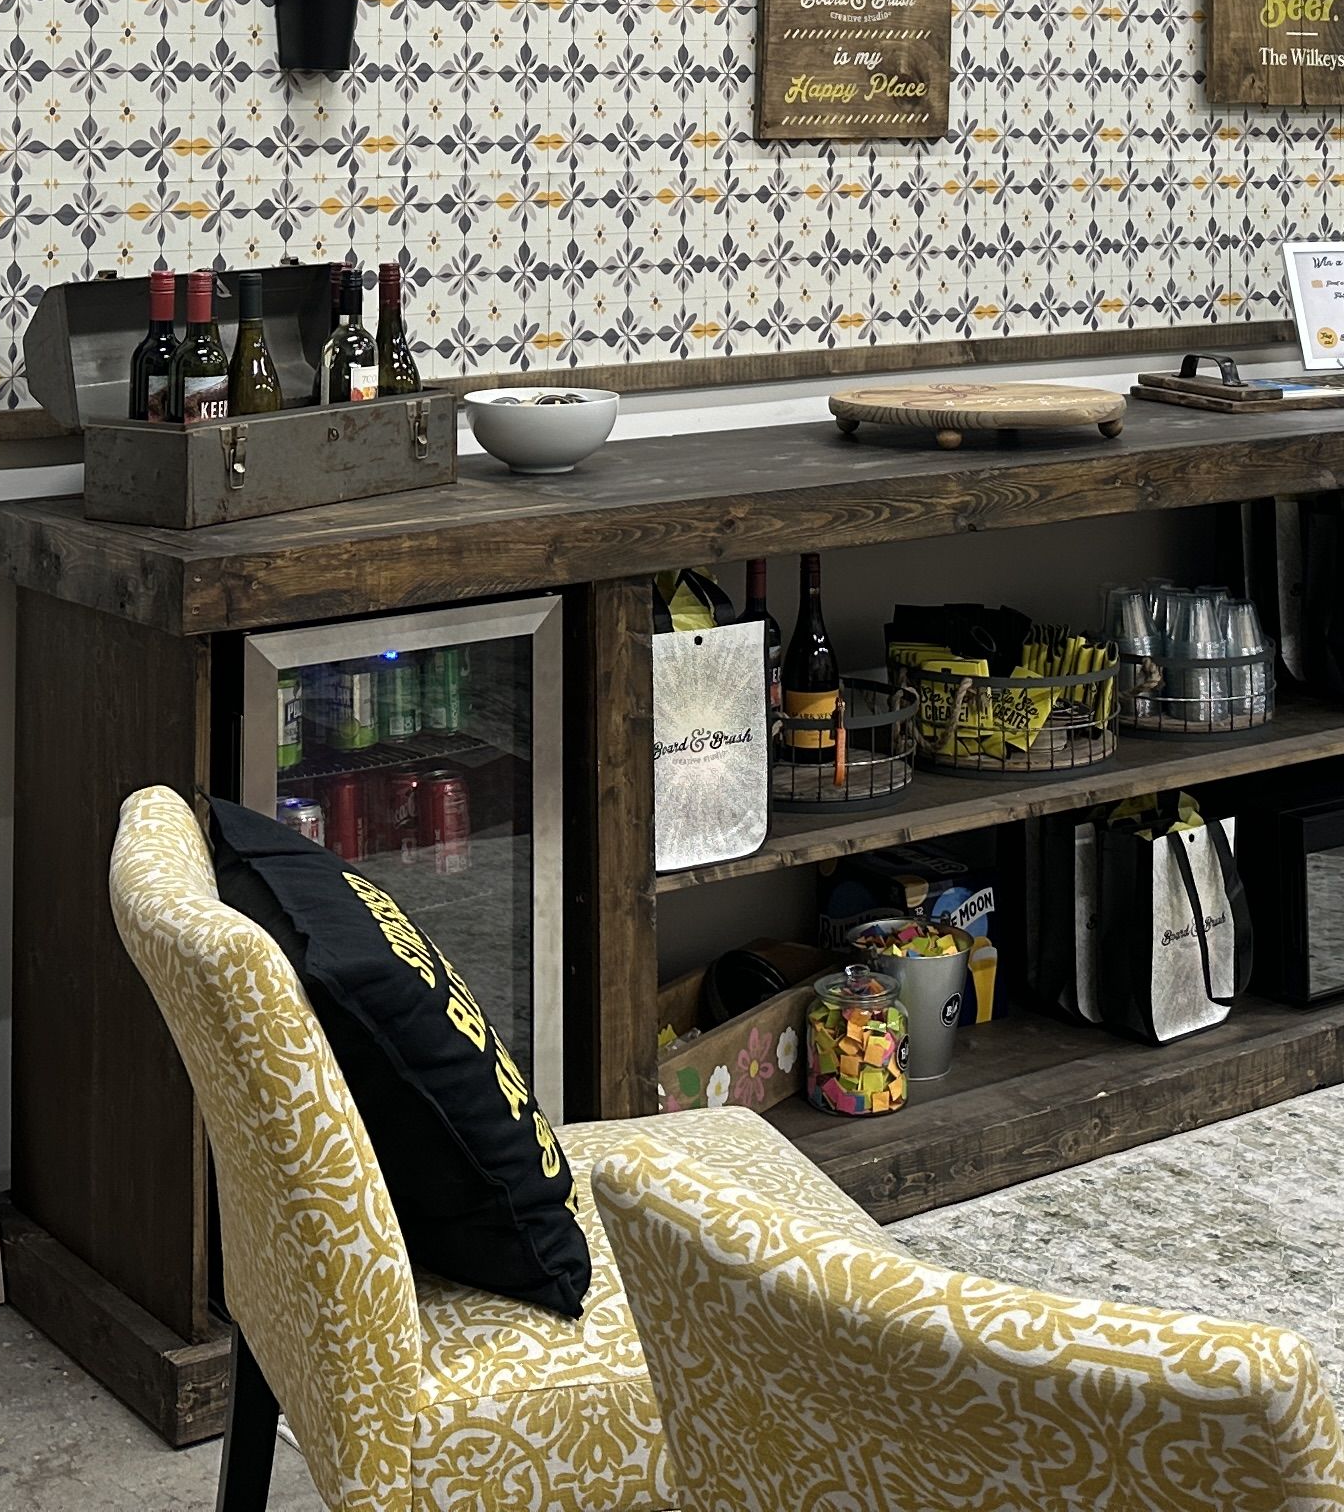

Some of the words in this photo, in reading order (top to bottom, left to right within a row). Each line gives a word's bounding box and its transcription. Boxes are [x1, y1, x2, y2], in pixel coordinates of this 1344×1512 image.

[833, 46, 851, 66] is
[854, 49, 884, 71] my
[1259, 47, 1288, 67] The
[784, 73, 860, 104] Happy
[863, 72, 927, 102] Place
[1312, 256, 1333, 268] Win
[709, 728, 754, 750] Brush
[959, 890, 995, 925] MOON
